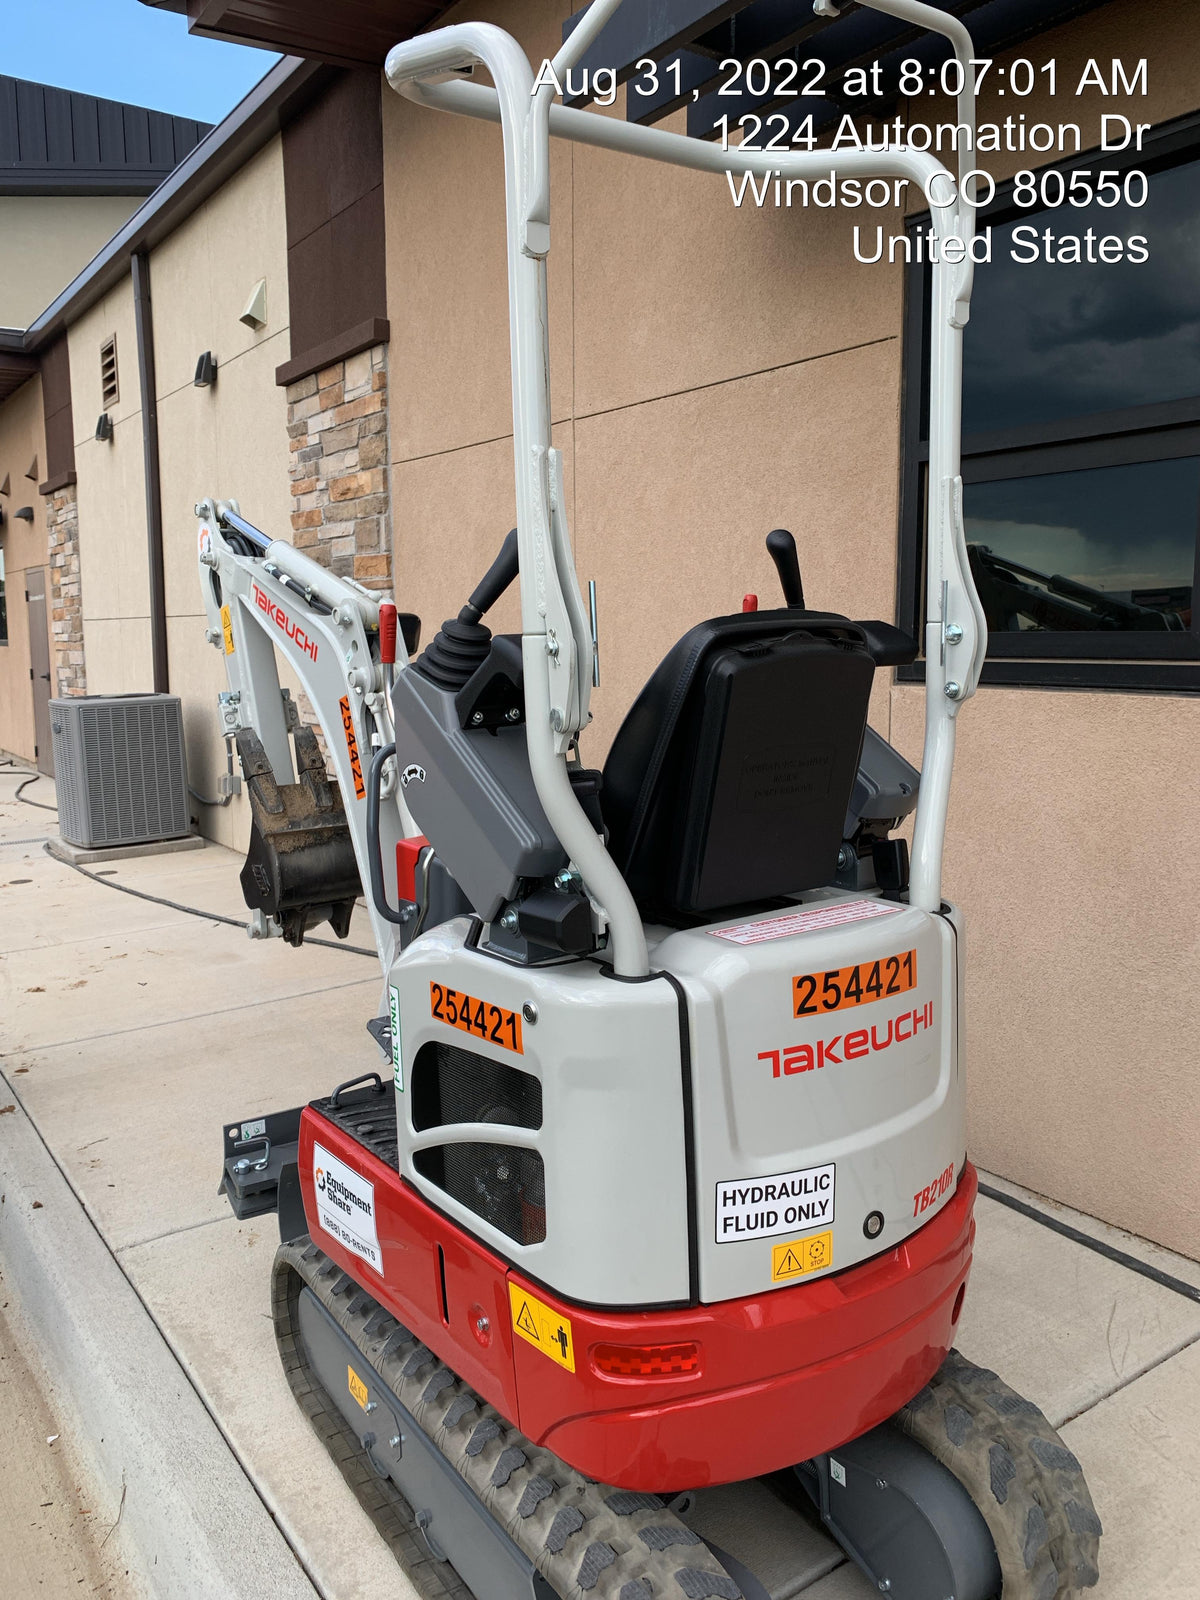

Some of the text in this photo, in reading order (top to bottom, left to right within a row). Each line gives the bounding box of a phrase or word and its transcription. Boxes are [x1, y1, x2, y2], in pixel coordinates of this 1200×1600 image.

[339, 698, 365, 795] 254421
[796, 951, 913, 1015] 254421
[390, 992, 398, 1037] ONLY
[431, 983, 518, 1050] 254421
[326, 1170, 372, 1216] Equipment
[722, 1173, 831, 1208] HYDRAULIC
[913, 1162, 954, 1218] TB210R
[323, 1215, 341, 1236] (888)
[723, 1199, 829, 1233] FLUID ONLY
[810, 1258, 824, 1267] STOP
